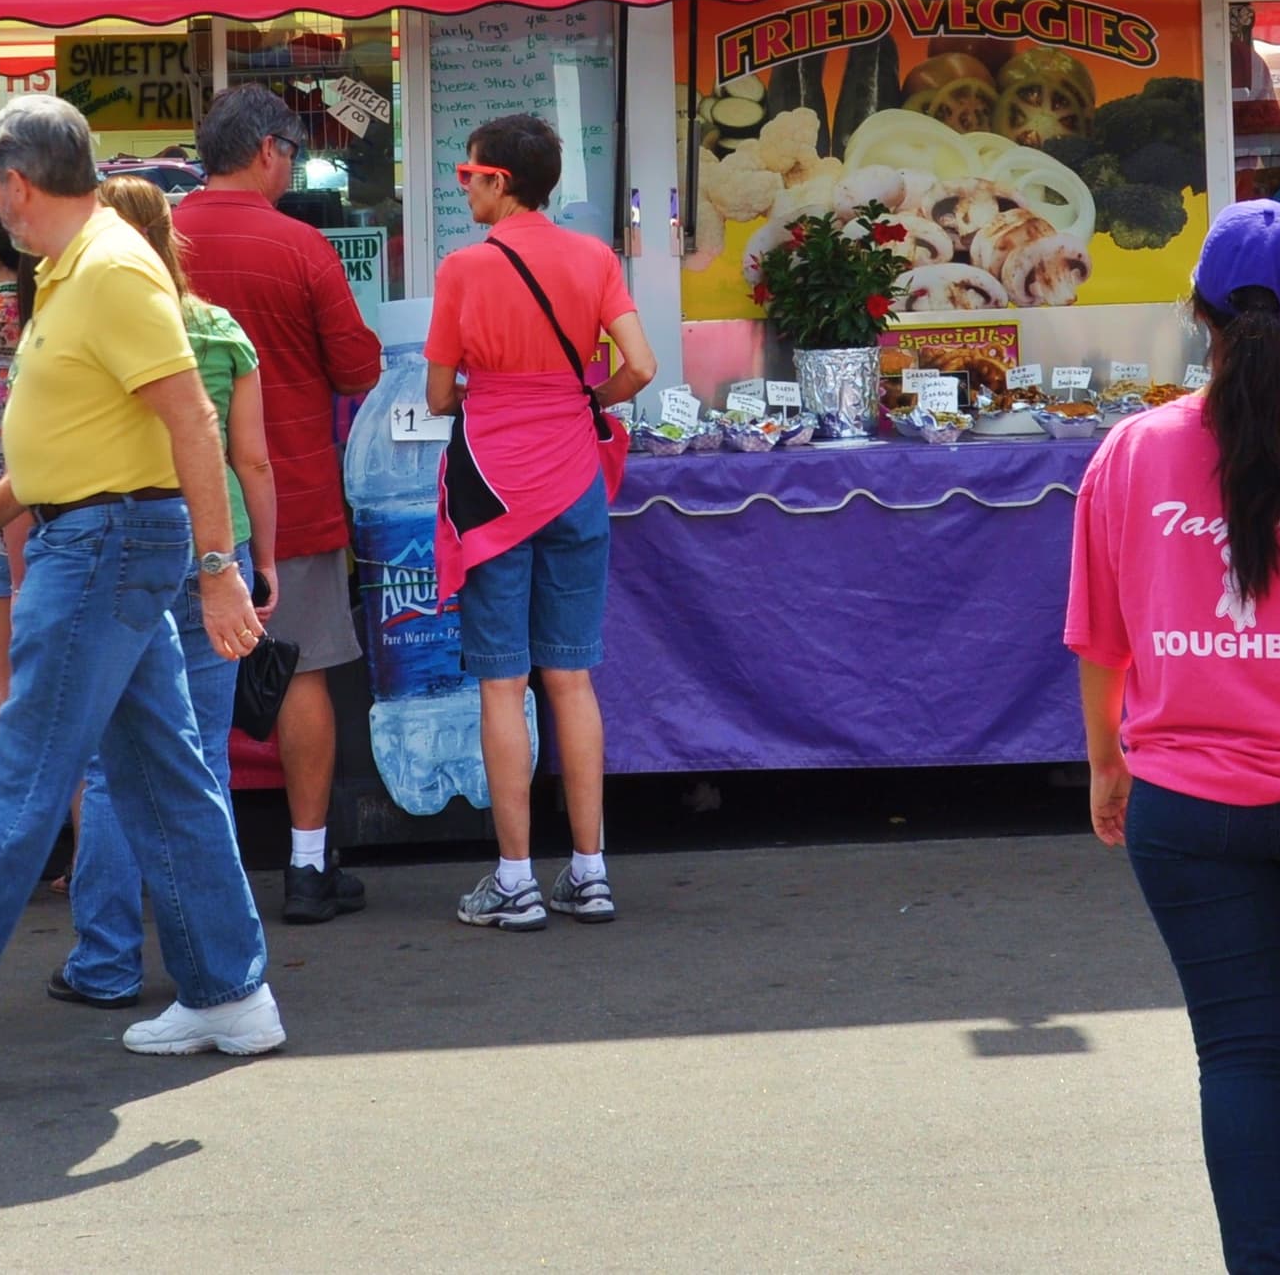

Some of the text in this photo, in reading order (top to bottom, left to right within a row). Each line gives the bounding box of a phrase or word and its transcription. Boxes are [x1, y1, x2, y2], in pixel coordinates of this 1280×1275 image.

[337, 78, 389, 119] WATER
[899, 327, 1016, 350] Specialty
[405, 630, 436, 645] Water
